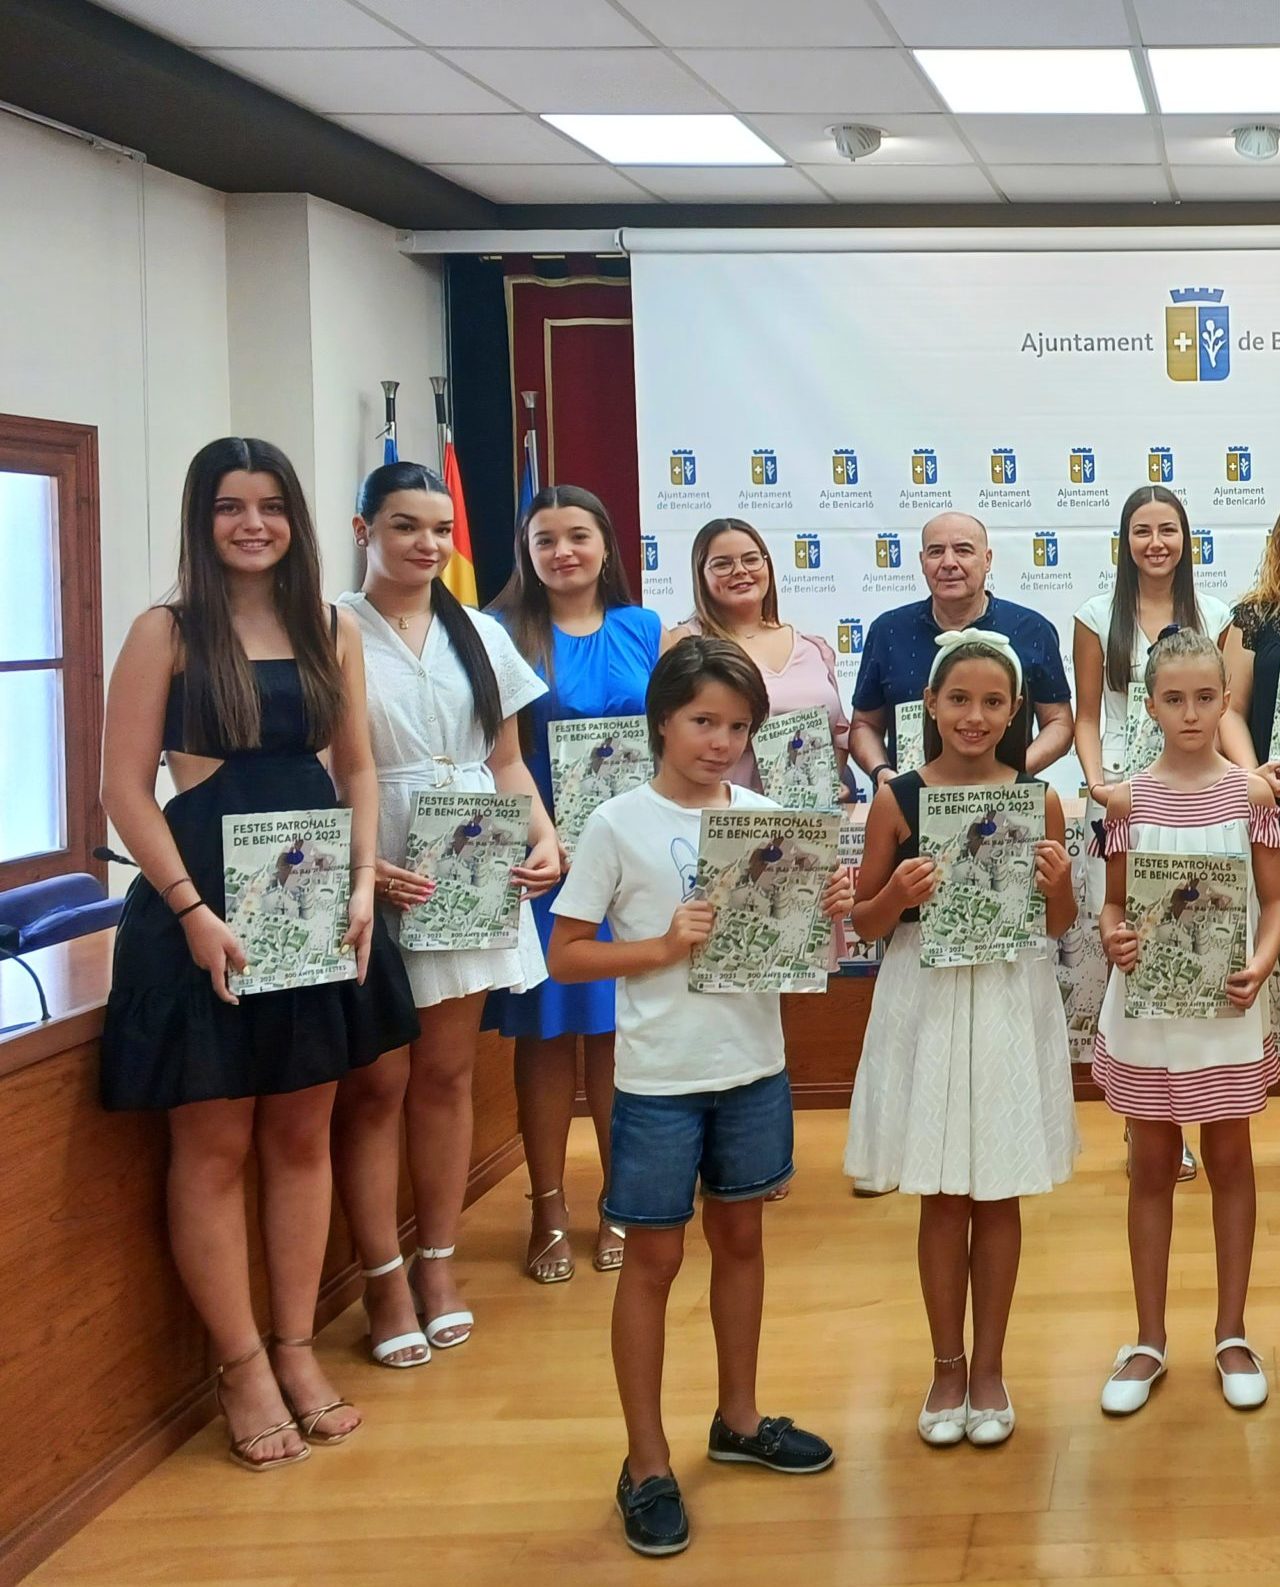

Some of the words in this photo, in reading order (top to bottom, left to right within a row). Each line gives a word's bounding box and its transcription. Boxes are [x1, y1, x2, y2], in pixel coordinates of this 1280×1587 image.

[1021, 332, 1154, 358] Ajuntament
[1238, 330, 1265, 351] de
[657, 491, 710, 501] Ajuntament
[739, 490, 791, 500] Ajuntament
[820, 490, 872, 500] Ajuntament
[900, 490, 952, 499] Ajuntament
[979, 489, 1030, 499] Ajuntament
[1058, 488, 1108, 498] Ajuntament
[1214, 487, 1264, 496] Ajuntament
[657, 501, 668, 509] de
[670, 501, 712, 509] Benicarló
[738, 501, 749, 509] de
[752, 501, 793, 509] Benicarló
[819, 500, 831, 509] de
[833, 500, 874, 509] Benicarló
[899, 500, 910, 508] de
[912, 500, 952, 508] Benicarló
[978, 499, 989, 508] de
[992, 499, 1032, 508] Benicarló
[1057, 498, 1068, 507] de
[1070, 498, 1110, 507] Benicarló
[1213, 497, 1224, 506] de
[1226, 497, 1265, 506] Benicarló
[782, 575, 834, 585] Ajuntament
[863, 573, 915, 583] Ajuntament
[1021, 572, 1072, 581] Ajuntament
[781, 584, 792, 593] de
[795, 584, 836, 593] Benicarló
[862, 583, 873, 592] de
[876, 583, 917, 592] Benicarló
[1020, 582, 1031, 590] de
[1034, 582, 1073, 590] Benicarló
[901, 704, 922, 713] FESTE
[555, 723, 586, 733] FESTES
[760, 721, 780, 733] ESTES
[556, 734, 568, 743] DE
[622, 729, 645, 739] 2023
[927, 792, 965, 803] FESTES
[967, 789, 1030, 801] PATRONALS
[418, 796, 454, 806] FESTES
[457, 797, 517, 807] PATRONALS
[928, 806, 942, 815] DE
[944, 800, 1005, 815] BENICARLÓ
[1008, 801, 1035, 812] 2023
[418, 808, 432, 816] DE
[495, 809, 520, 818] 2023
[233, 822, 273, 835] FESTES
[276, 818, 337, 831] PATRONALS
[709, 816, 750, 827] FESTES
[753, 816, 823, 828] PATRONALS
[233, 836, 250, 847] DE
[252, 831, 313, 845] BENICARLÓ
[315, 830, 341, 841] 2023
[708, 829, 724, 839] DE
[727, 828, 795, 839] BENICARLÓ
[798, 829, 827, 839] 2023
[1134, 858, 1169, 869] FESTES
[1172, 859, 1232, 871] PATRONALS
[1134, 869, 1147, 879] DE
[1150, 870, 1208, 881] BENICARLÓ
[1211, 873, 1237, 882] 2023
